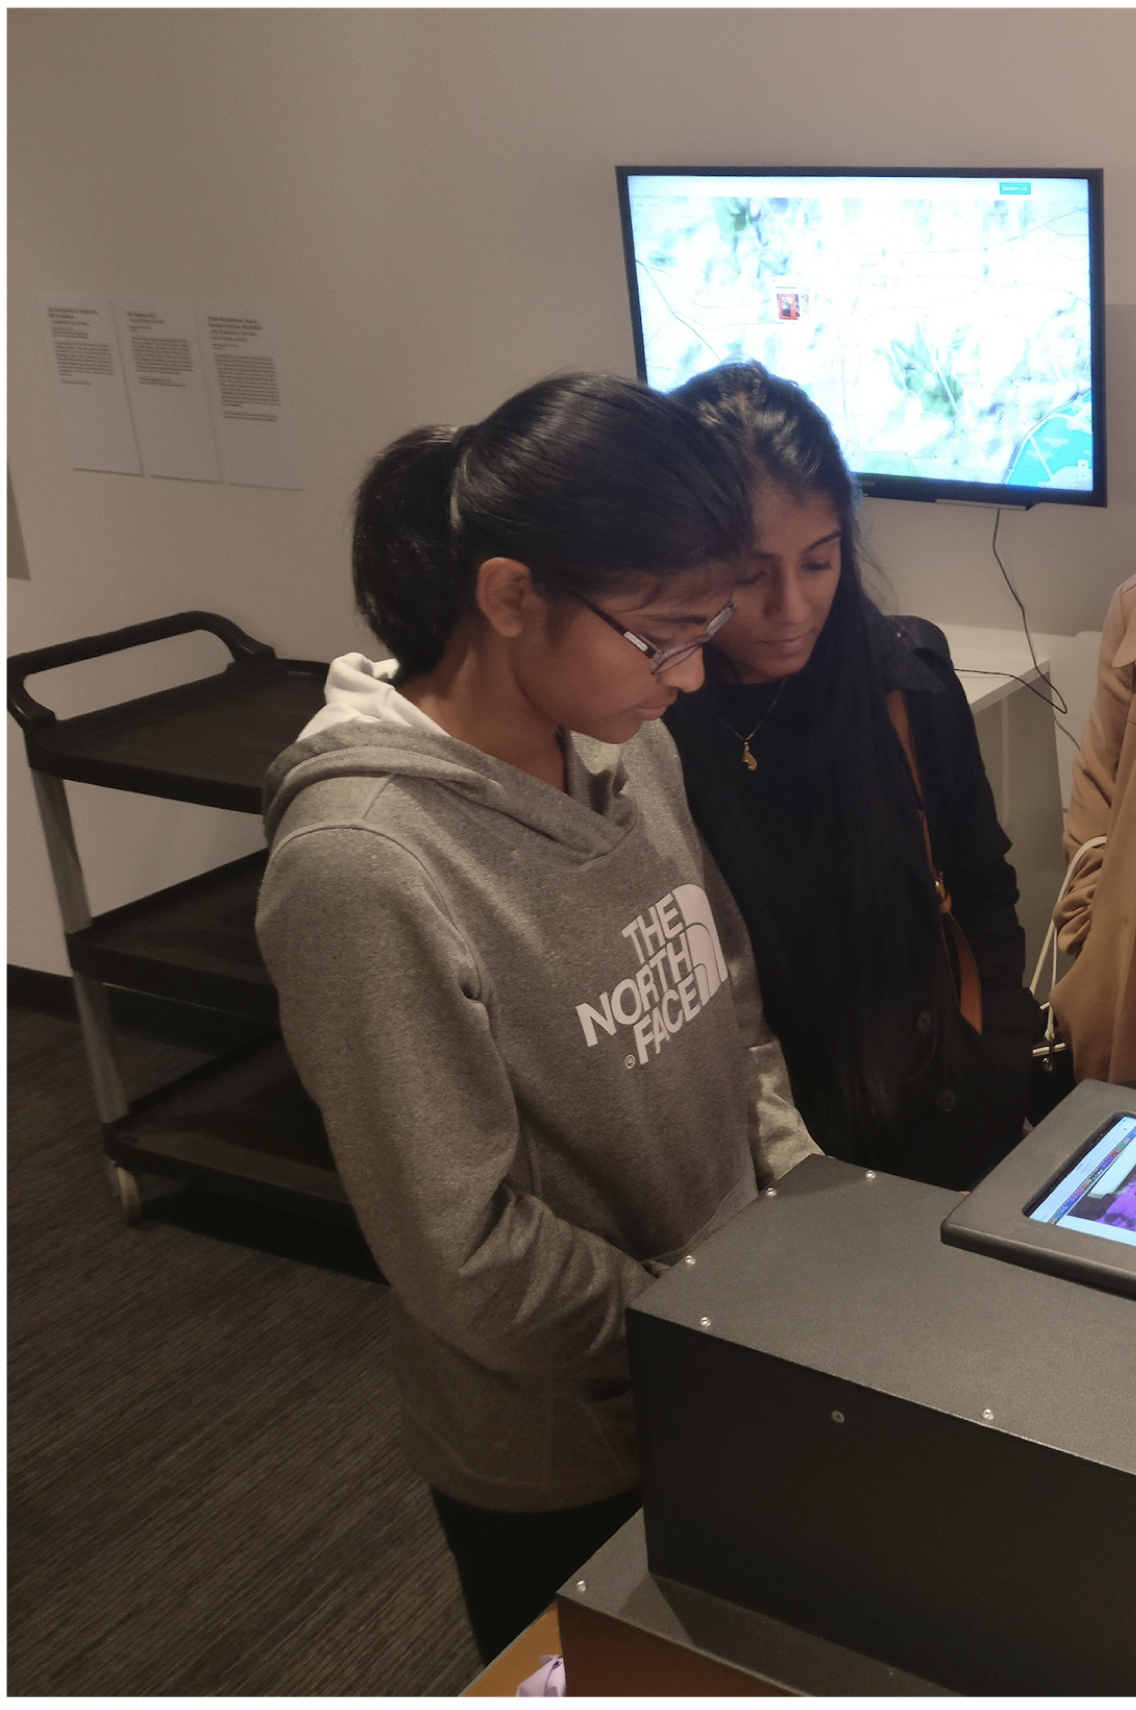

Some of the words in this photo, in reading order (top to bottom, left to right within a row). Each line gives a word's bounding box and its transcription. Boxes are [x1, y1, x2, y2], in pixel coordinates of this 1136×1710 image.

[621, 893, 685, 964] THE
[576, 932, 692, 1047] NORTH
[634, 972, 701, 1065] FACE
